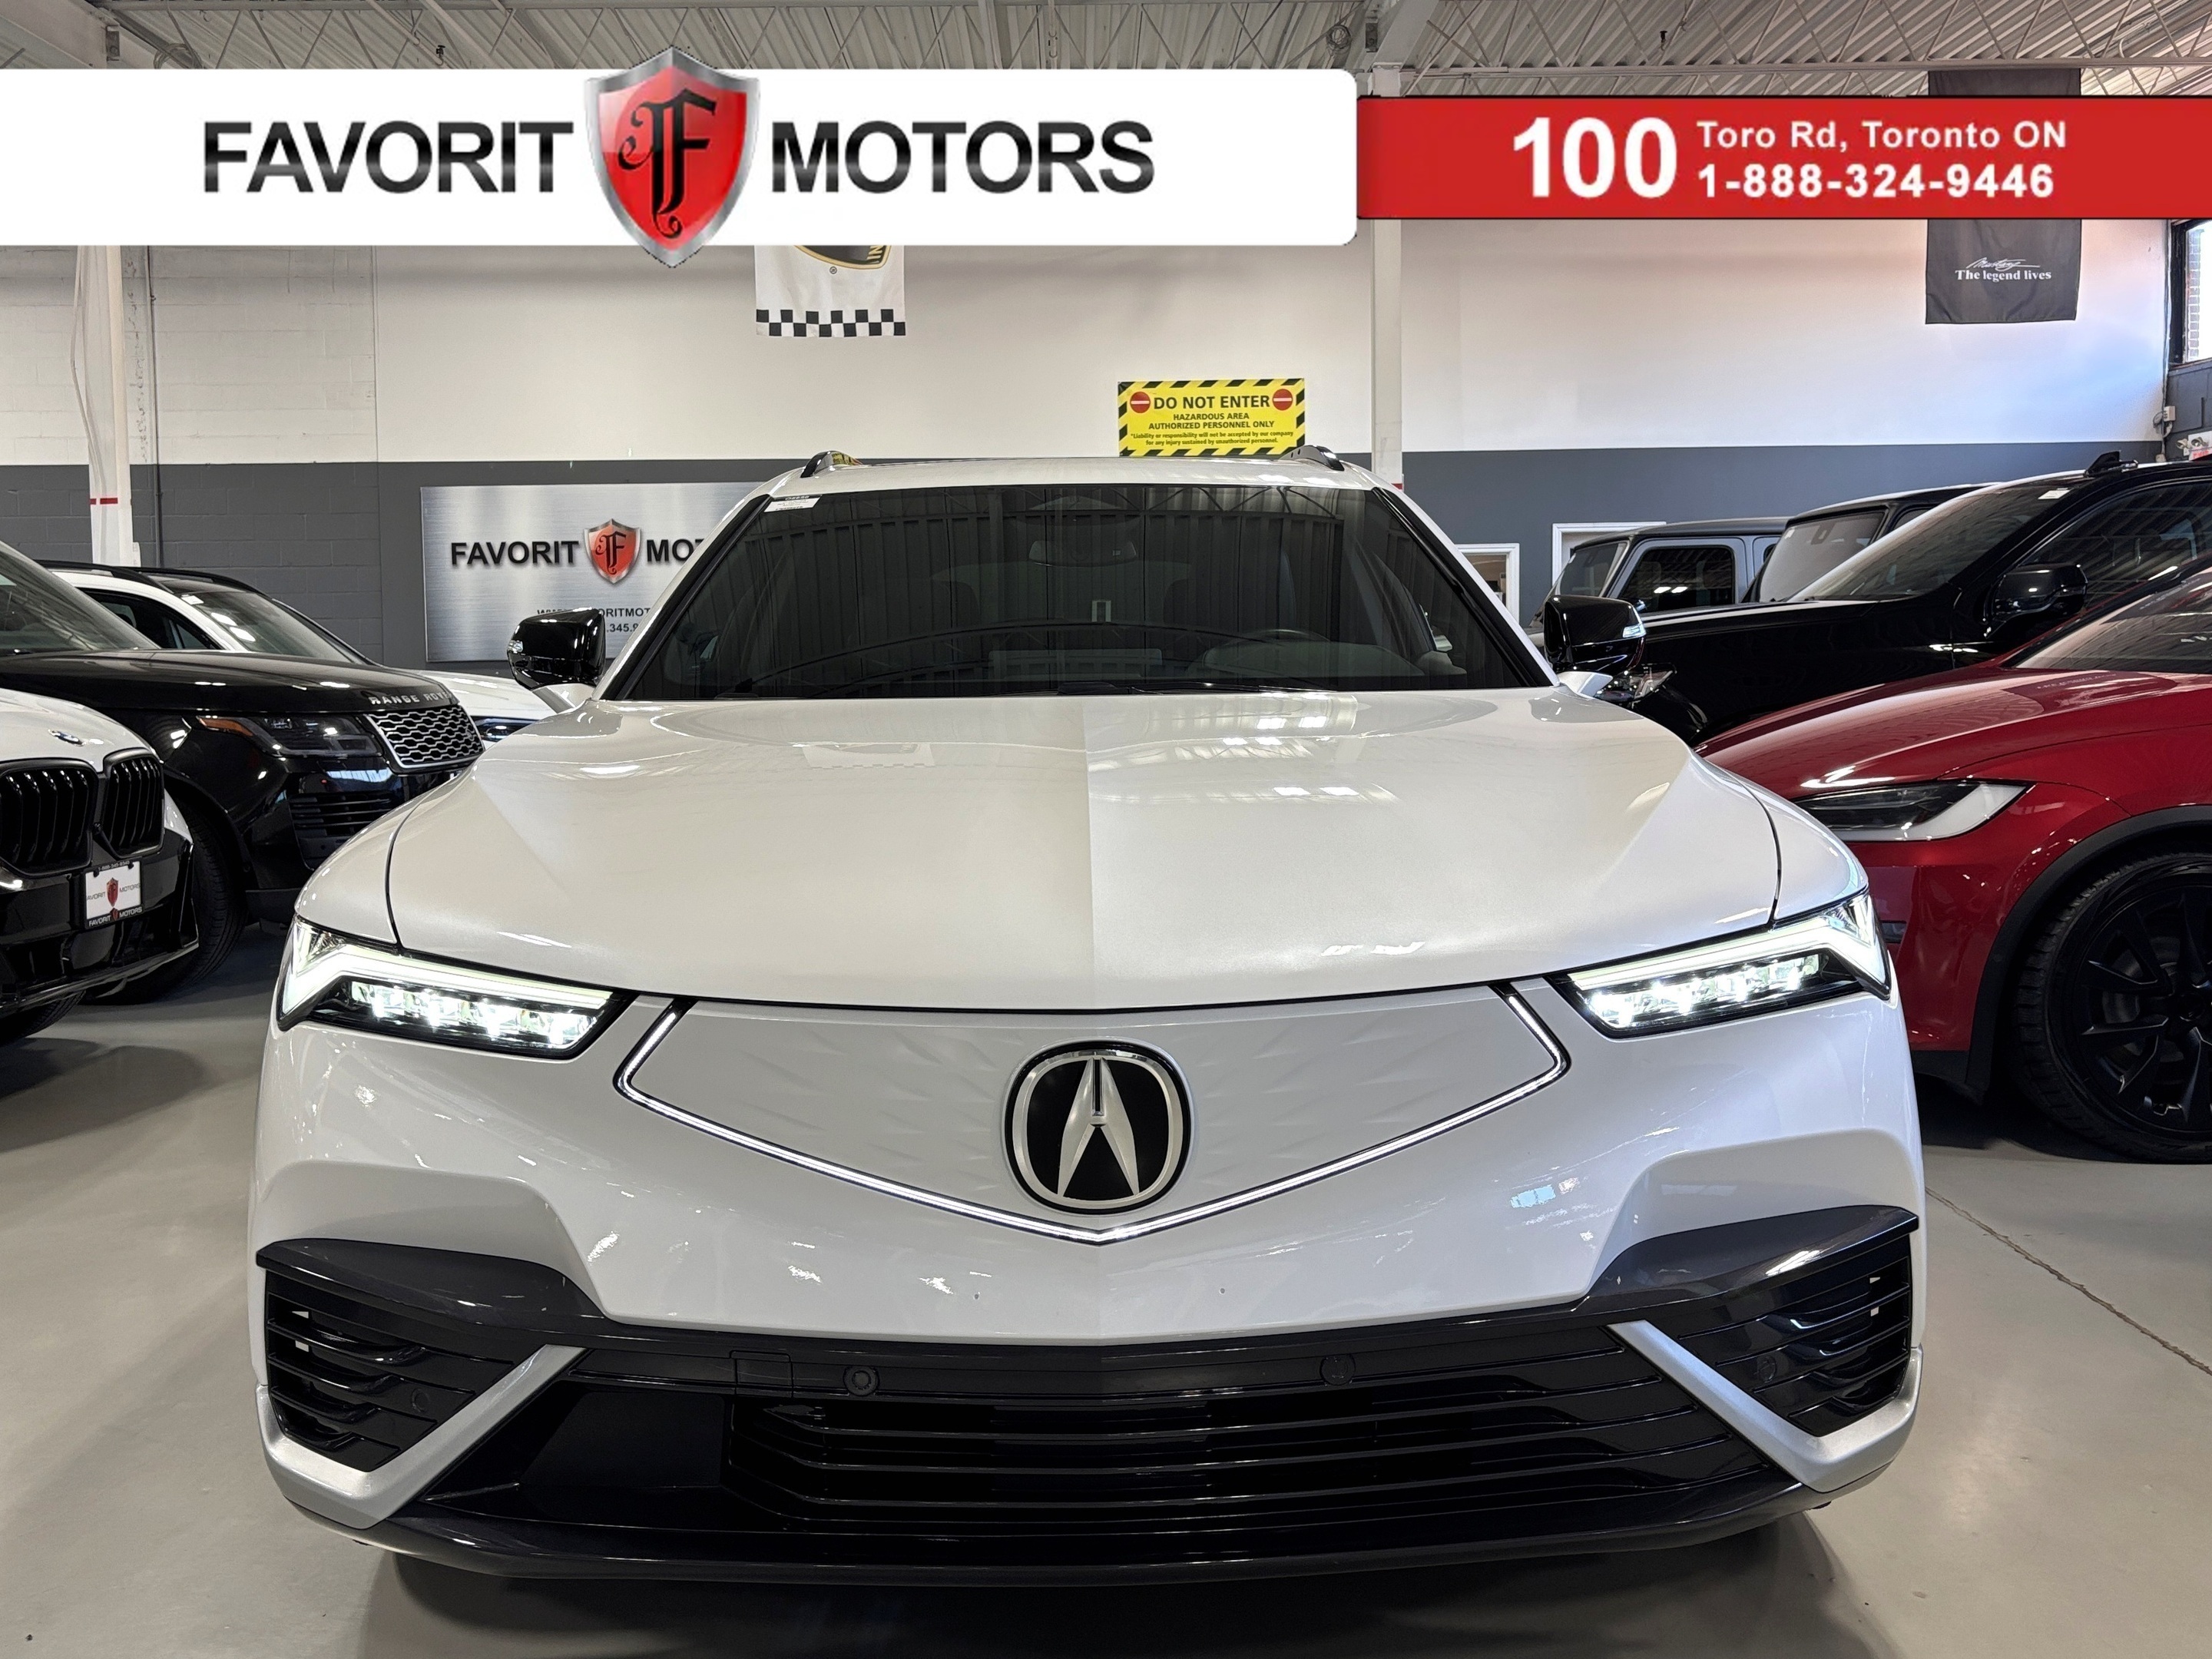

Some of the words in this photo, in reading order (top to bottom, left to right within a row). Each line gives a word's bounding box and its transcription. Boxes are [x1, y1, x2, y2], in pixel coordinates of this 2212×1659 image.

[1955, 270, 1980, 280] The
[1983, 270, 2021, 282] legend
[2024, 271, 2051, 280] lives
[1154, 397, 1177, 409] DO
[1183, 396, 1215, 409] NOT
[1220, 395, 1270, 408] ENTER
[452, 541, 578, 565] FAVORIT
[369, 695, 419, 704] RANGE
[87, 892, 105, 900] AVORIT
[89, 916, 111, 926] FAVORIT
[120, 907, 142, 917] MOTORS
